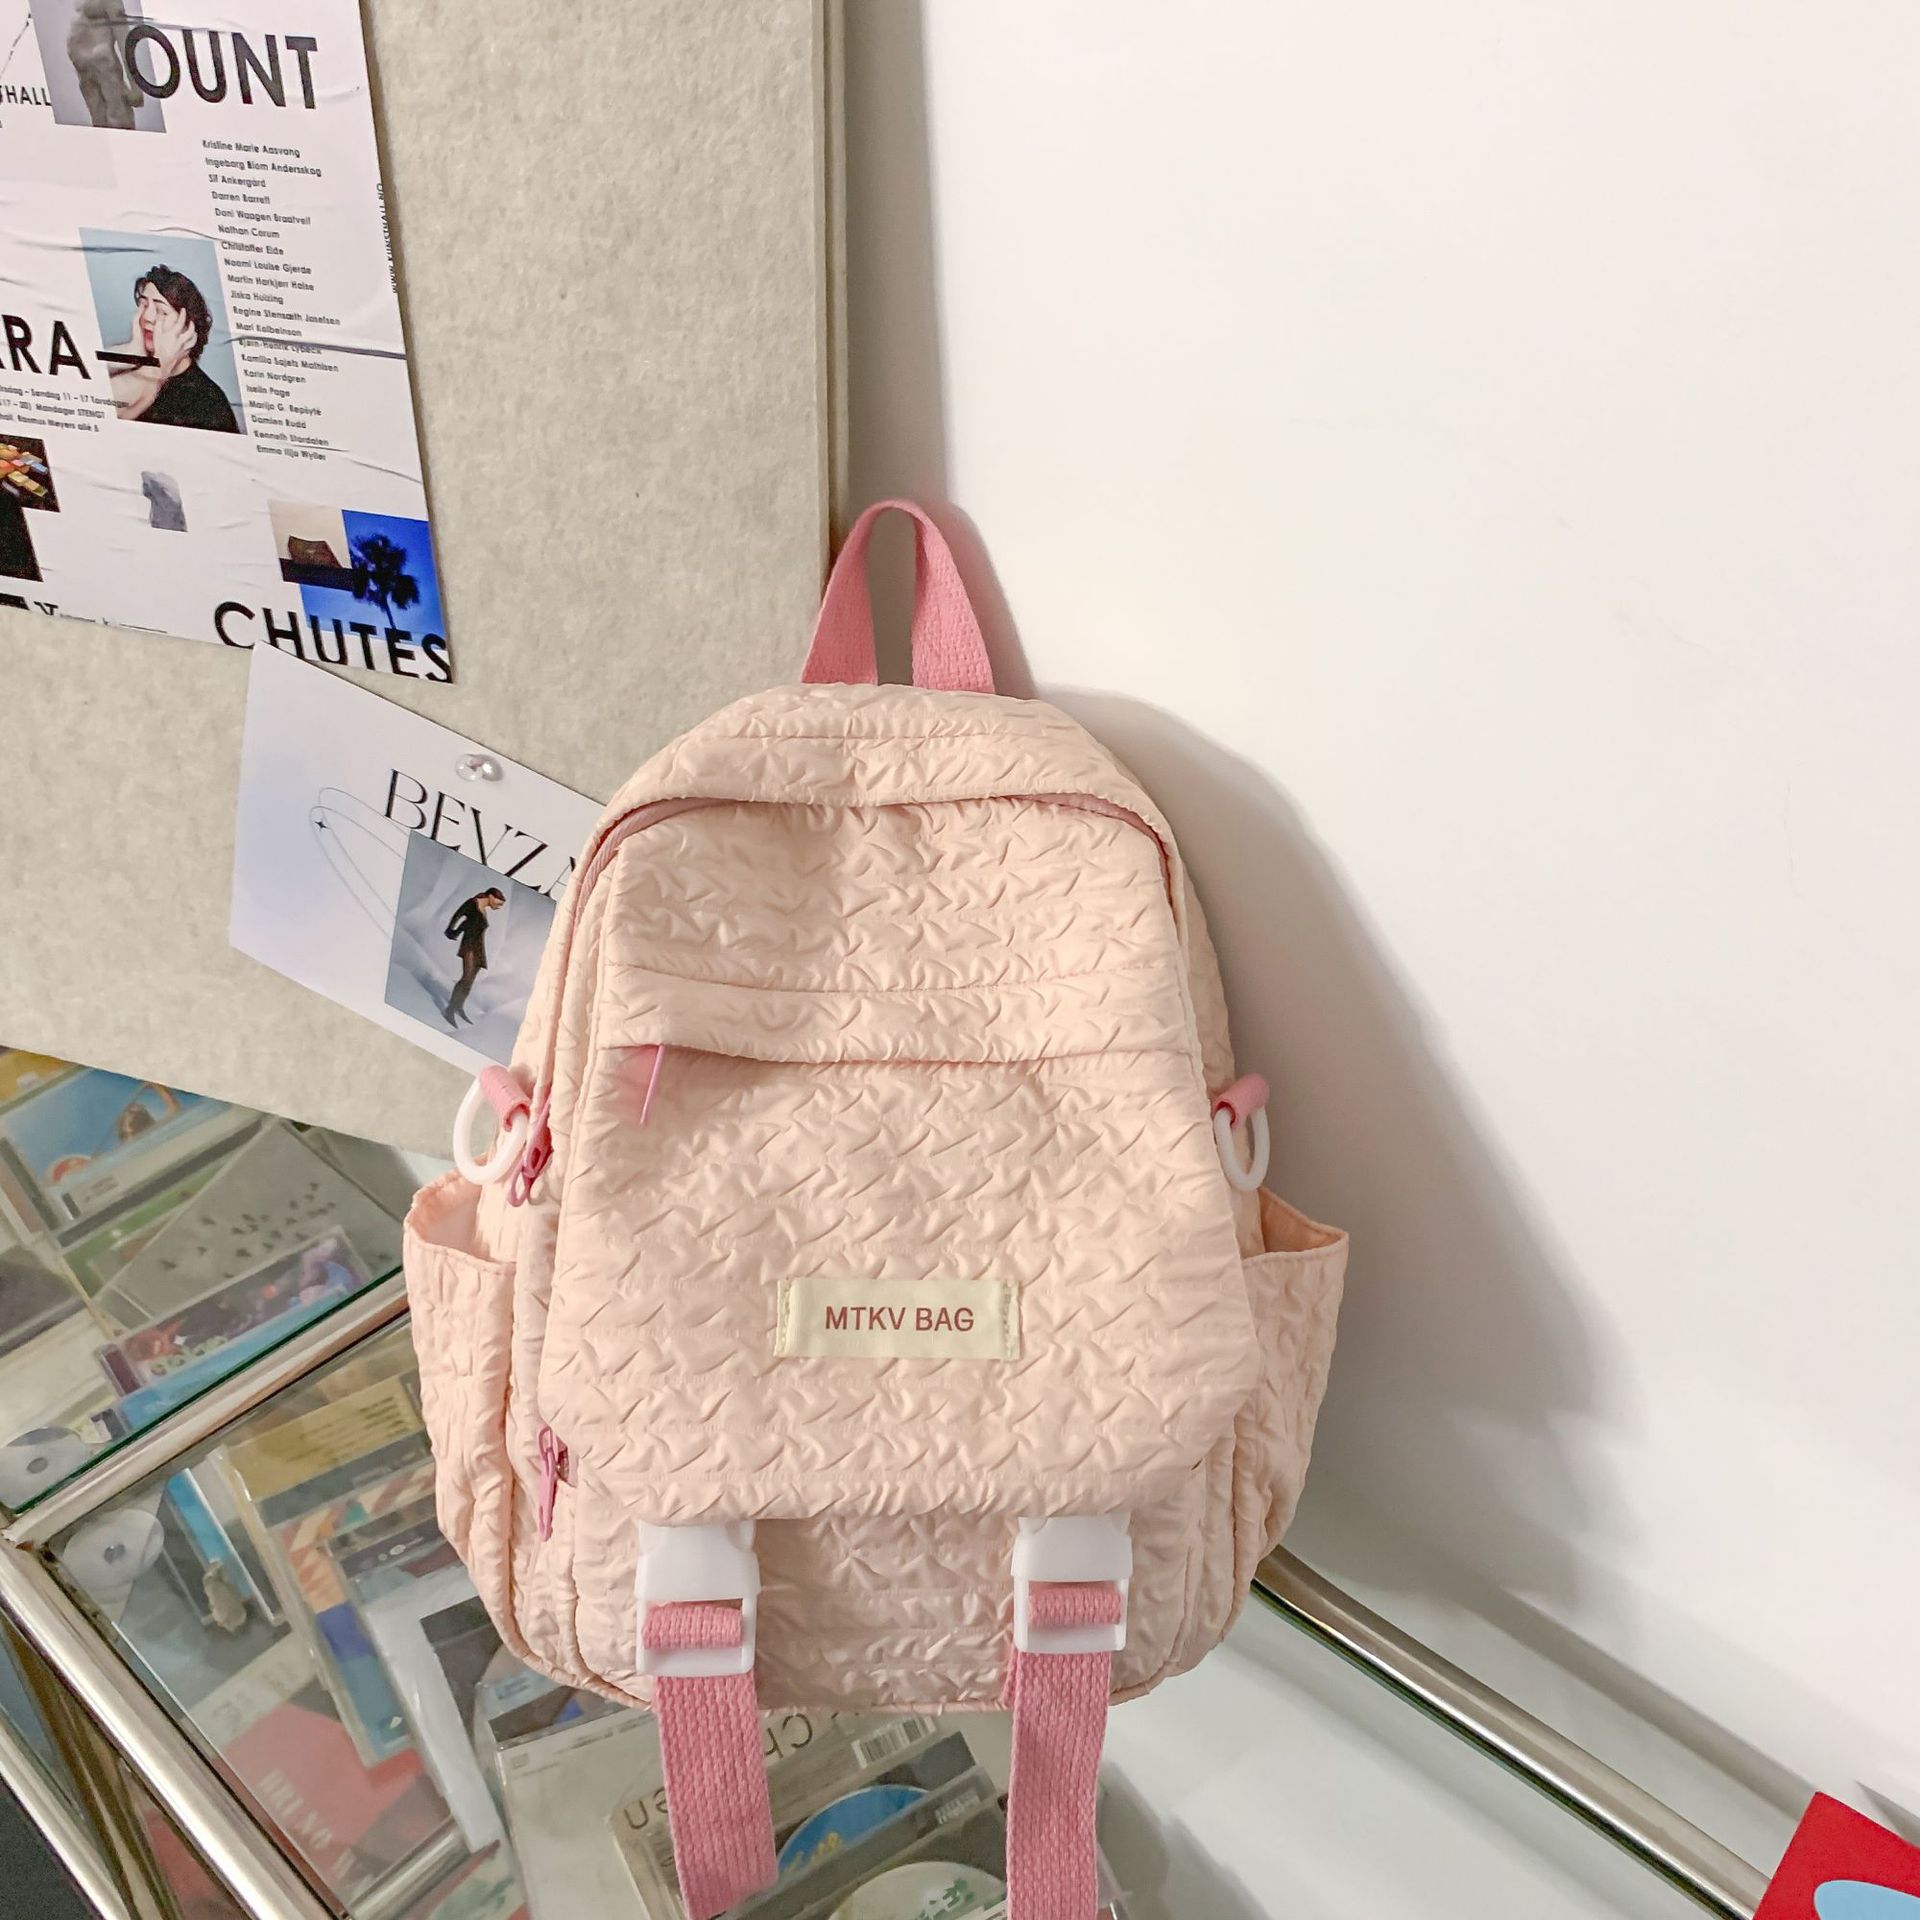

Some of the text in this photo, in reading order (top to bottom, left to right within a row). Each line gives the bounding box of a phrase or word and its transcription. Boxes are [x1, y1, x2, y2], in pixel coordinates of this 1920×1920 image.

[124, 24, 318, 109] OUNT
[235, 142, 260, 153] Marie
[214, 601, 453, 684] CHUTES
[825, 1306, 974, 1331] MTKV BAG
